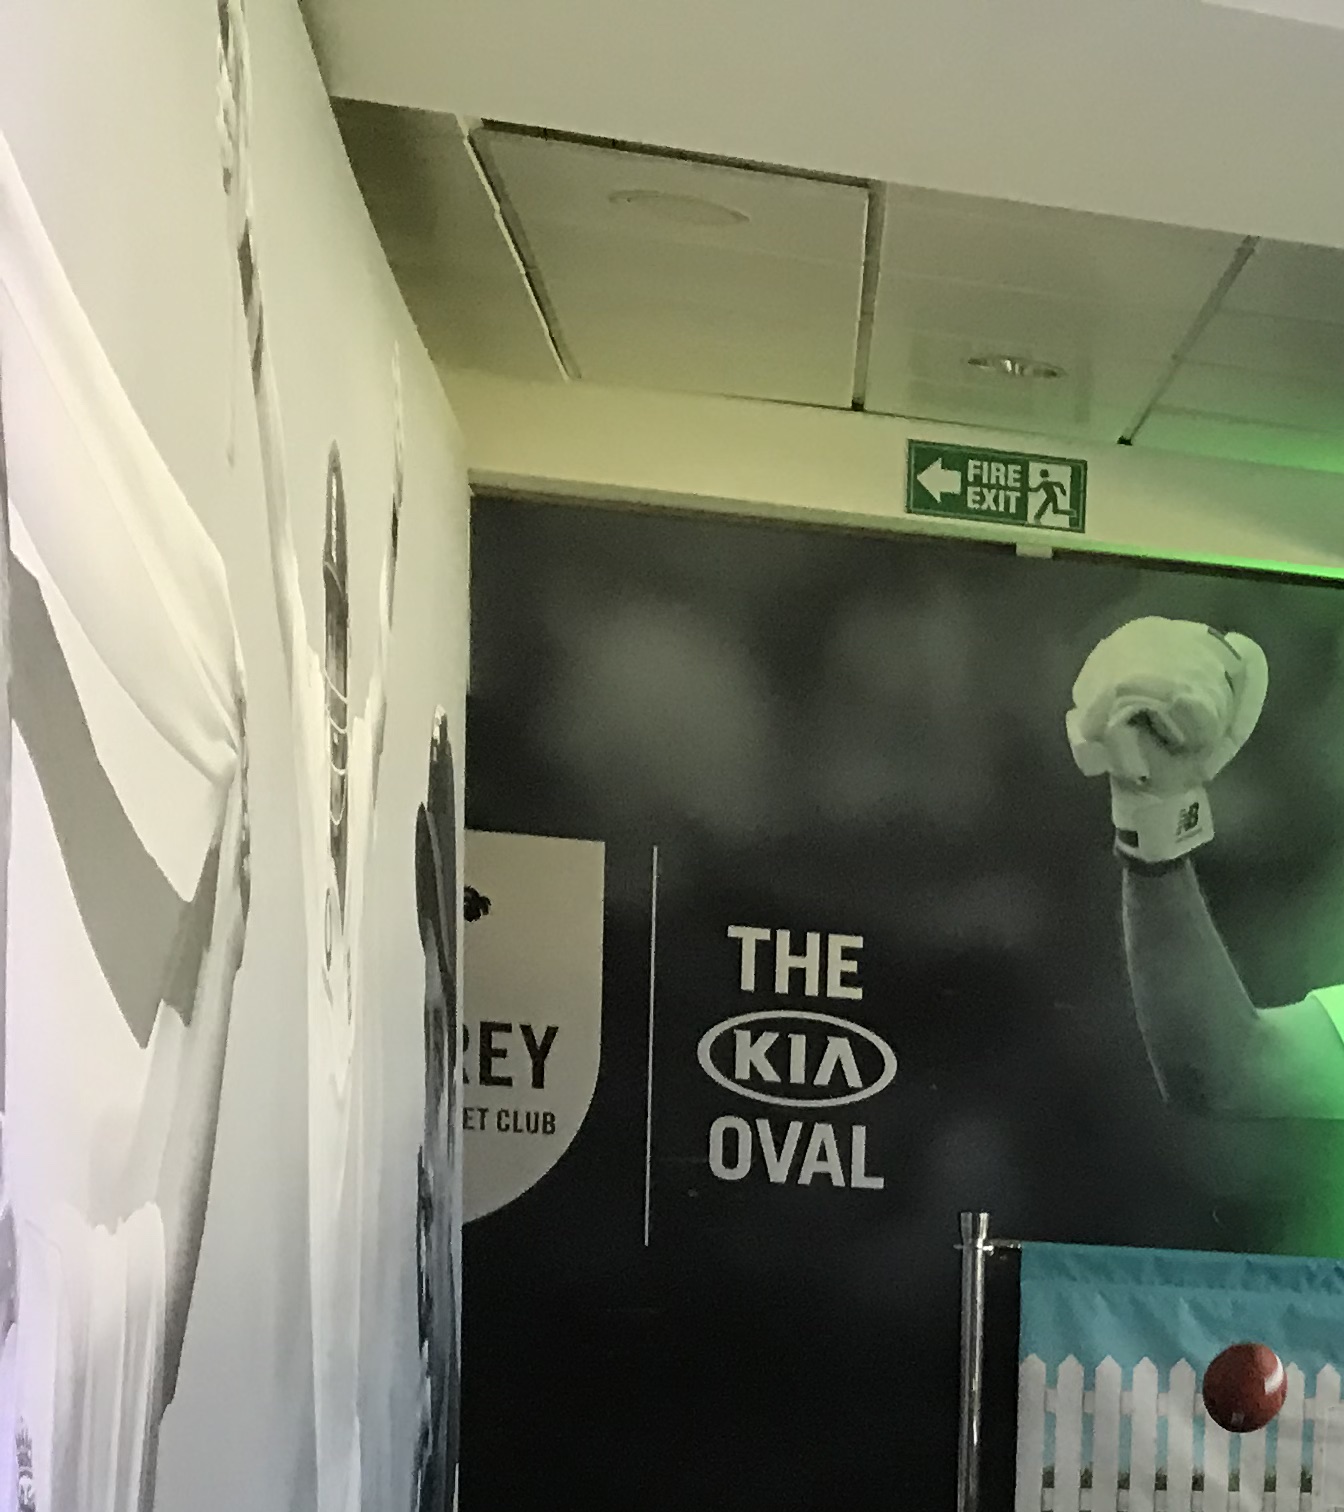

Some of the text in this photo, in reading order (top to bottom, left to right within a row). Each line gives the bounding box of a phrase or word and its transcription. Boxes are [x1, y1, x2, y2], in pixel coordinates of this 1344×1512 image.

[967, 459, 1022, 487] FIRE
[966, 486, 1021, 514] EXIT
[727, 924, 864, 1001] THE
[733, 1029, 864, 1090] KIA
[496, 1108, 556, 1136] CLUB
[708, 1114, 885, 1191] OVAL
